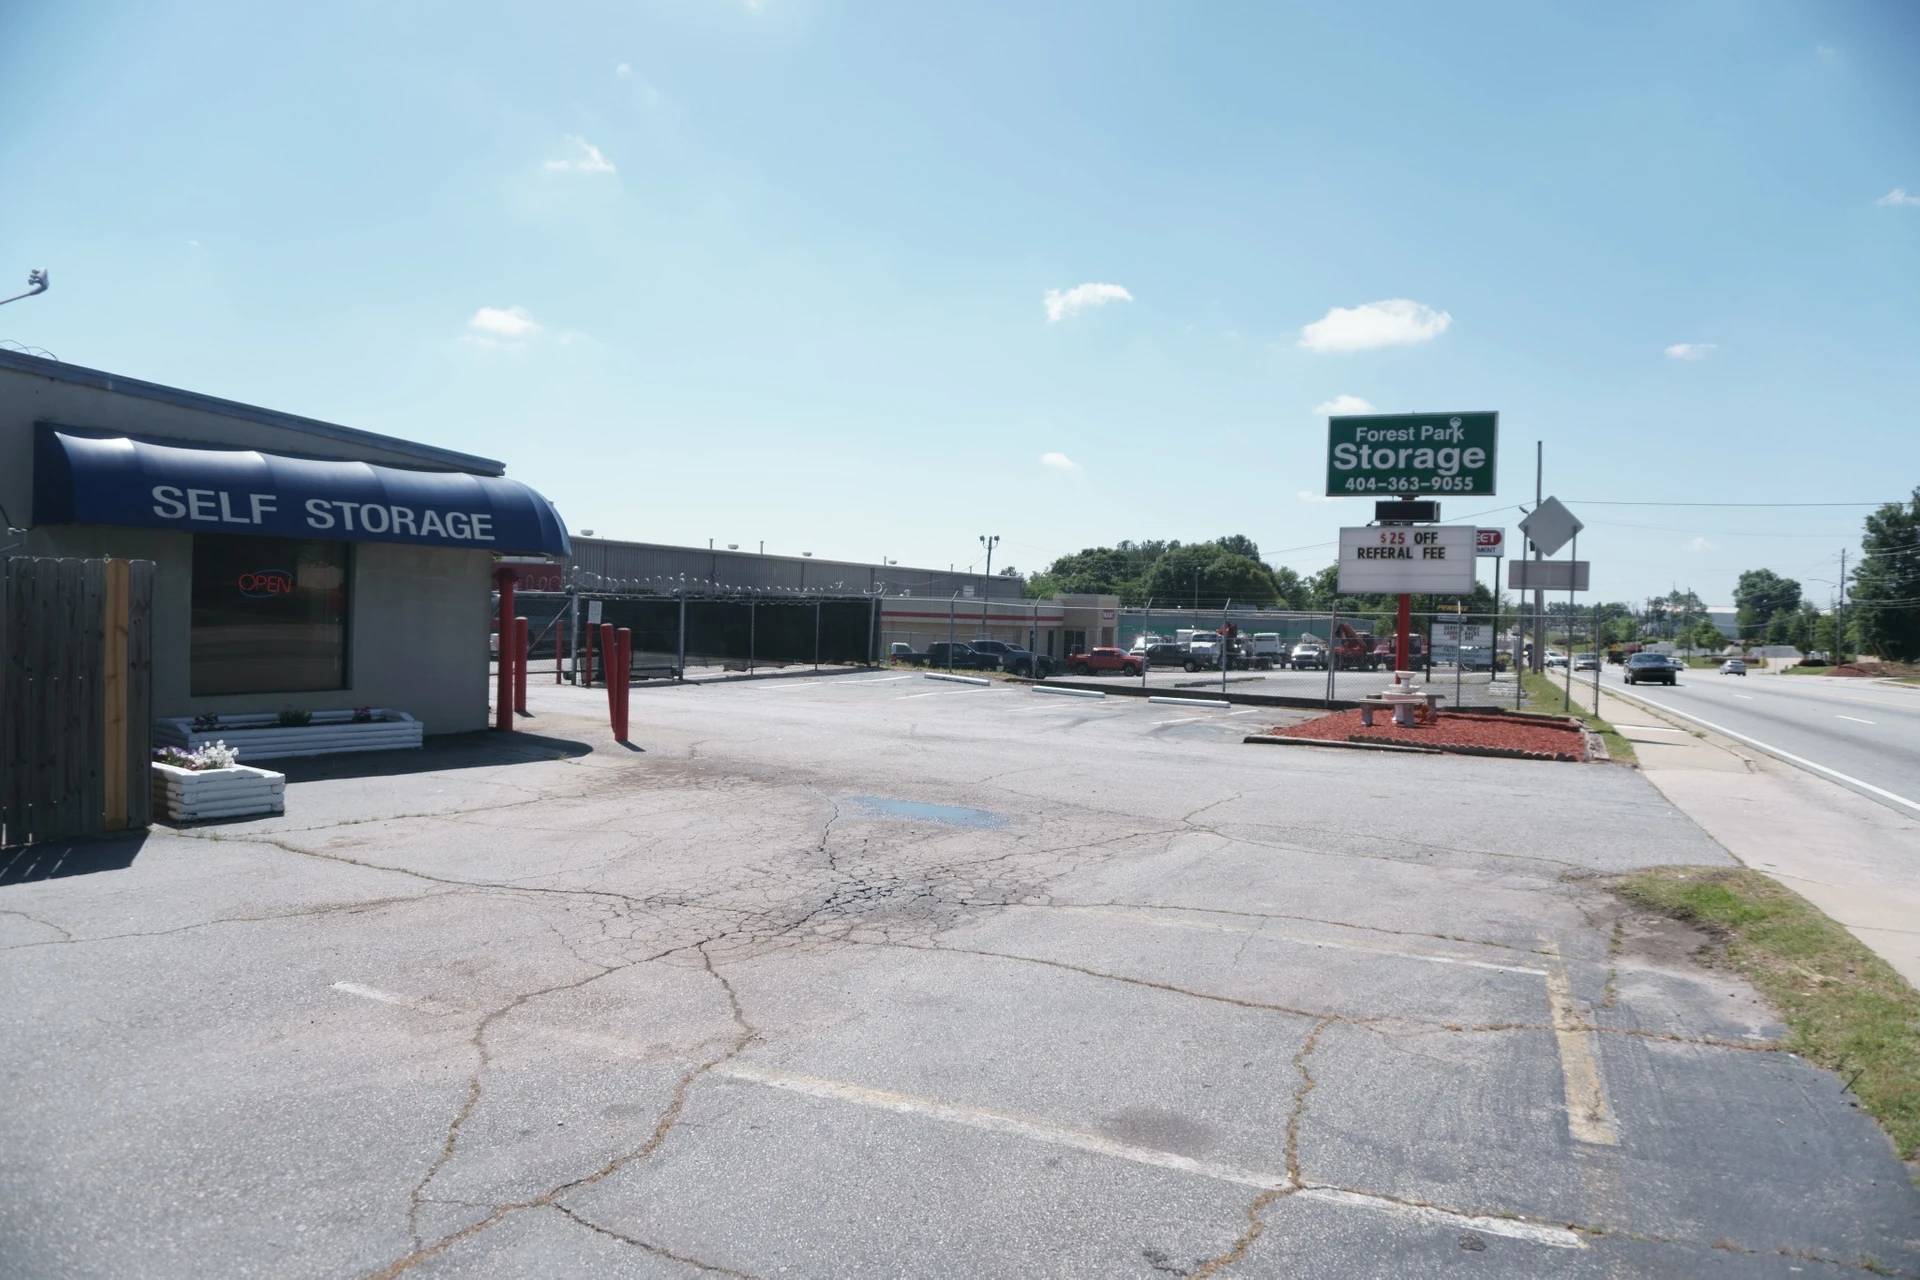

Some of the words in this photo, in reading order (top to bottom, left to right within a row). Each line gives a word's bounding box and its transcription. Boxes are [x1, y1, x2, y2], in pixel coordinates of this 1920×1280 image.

[1356, 426, 1415, 442] Forest
[1421, 421, 1465, 443] Park
[1333, 443, 1486, 476] Storage
[1345, 476, 1474, 491] 404-363-9055
[152, 484, 278, 524] SELF
[305, 497, 496, 541] STORAGE
[1380, 532, 1406, 545] $25
[1414, 532, 1439, 545] OFF
[1476, 532, 1498, 543] EET
[1357, 547, 1414, 560] REFERAL
[1423, 547, 1446, 560] FEE
[238, 573, 291, 594] OPEN
